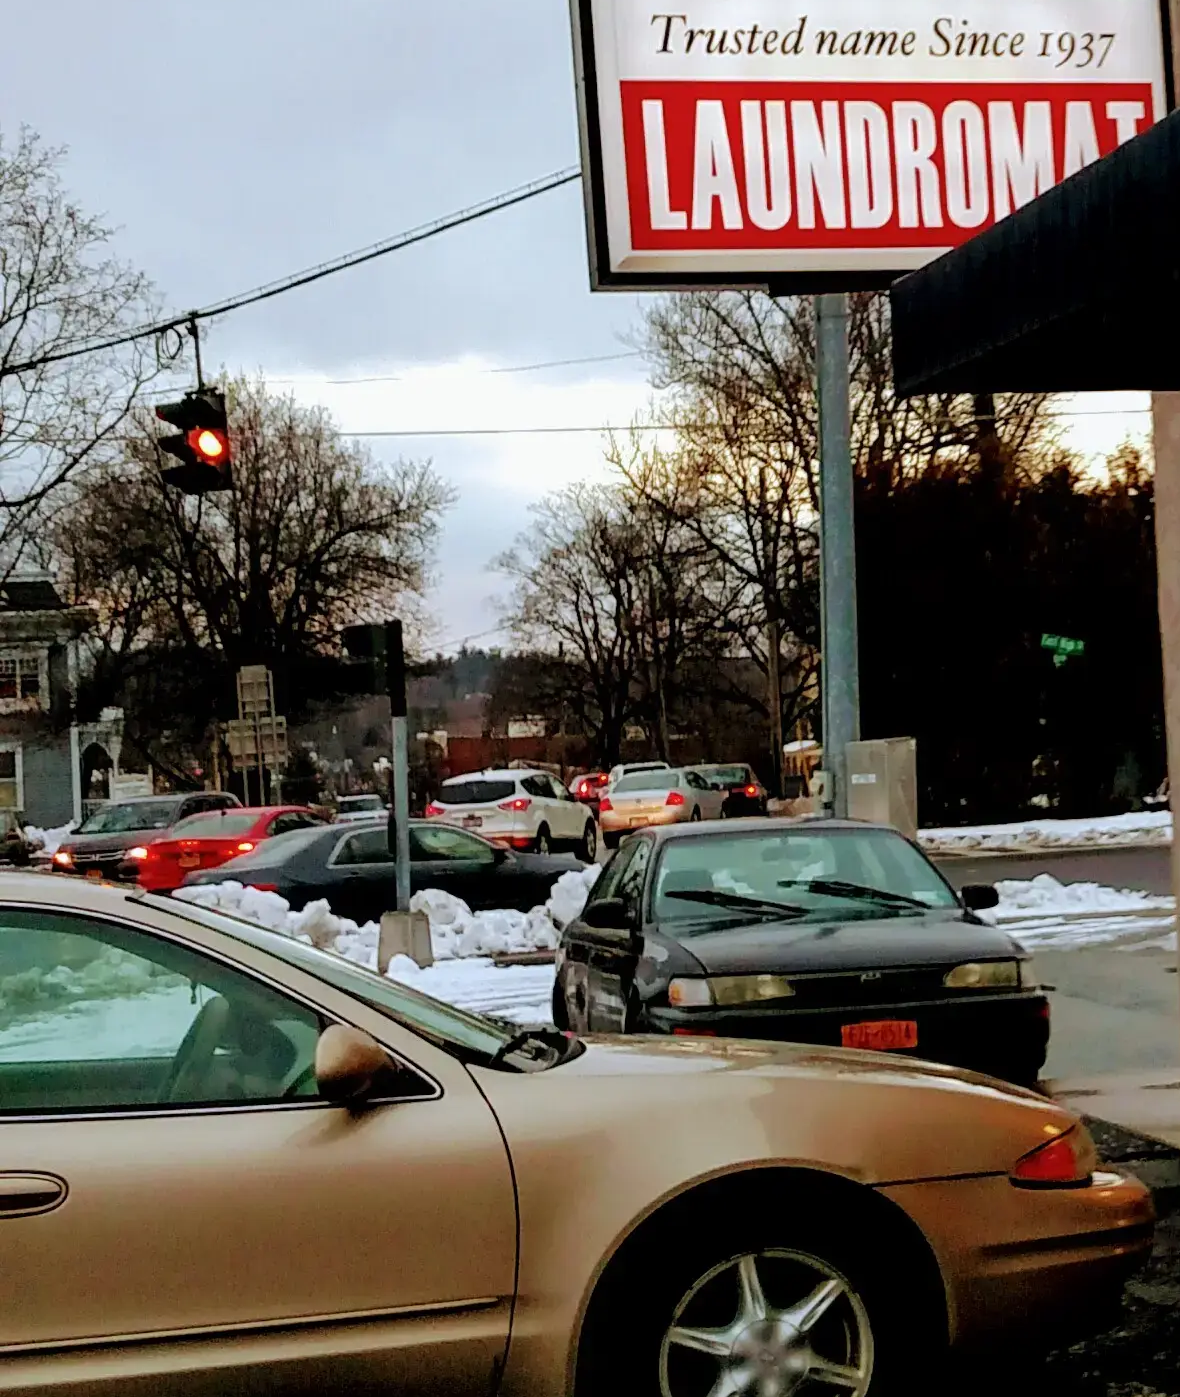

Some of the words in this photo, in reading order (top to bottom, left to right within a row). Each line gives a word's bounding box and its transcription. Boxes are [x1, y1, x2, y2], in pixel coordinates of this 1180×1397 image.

[650, 14, 808, 57] Trusted
[815, 27, 917, 58] name
[928, 17, 1025, 59] Since
[1036, 31, 1116, 70] 1937
